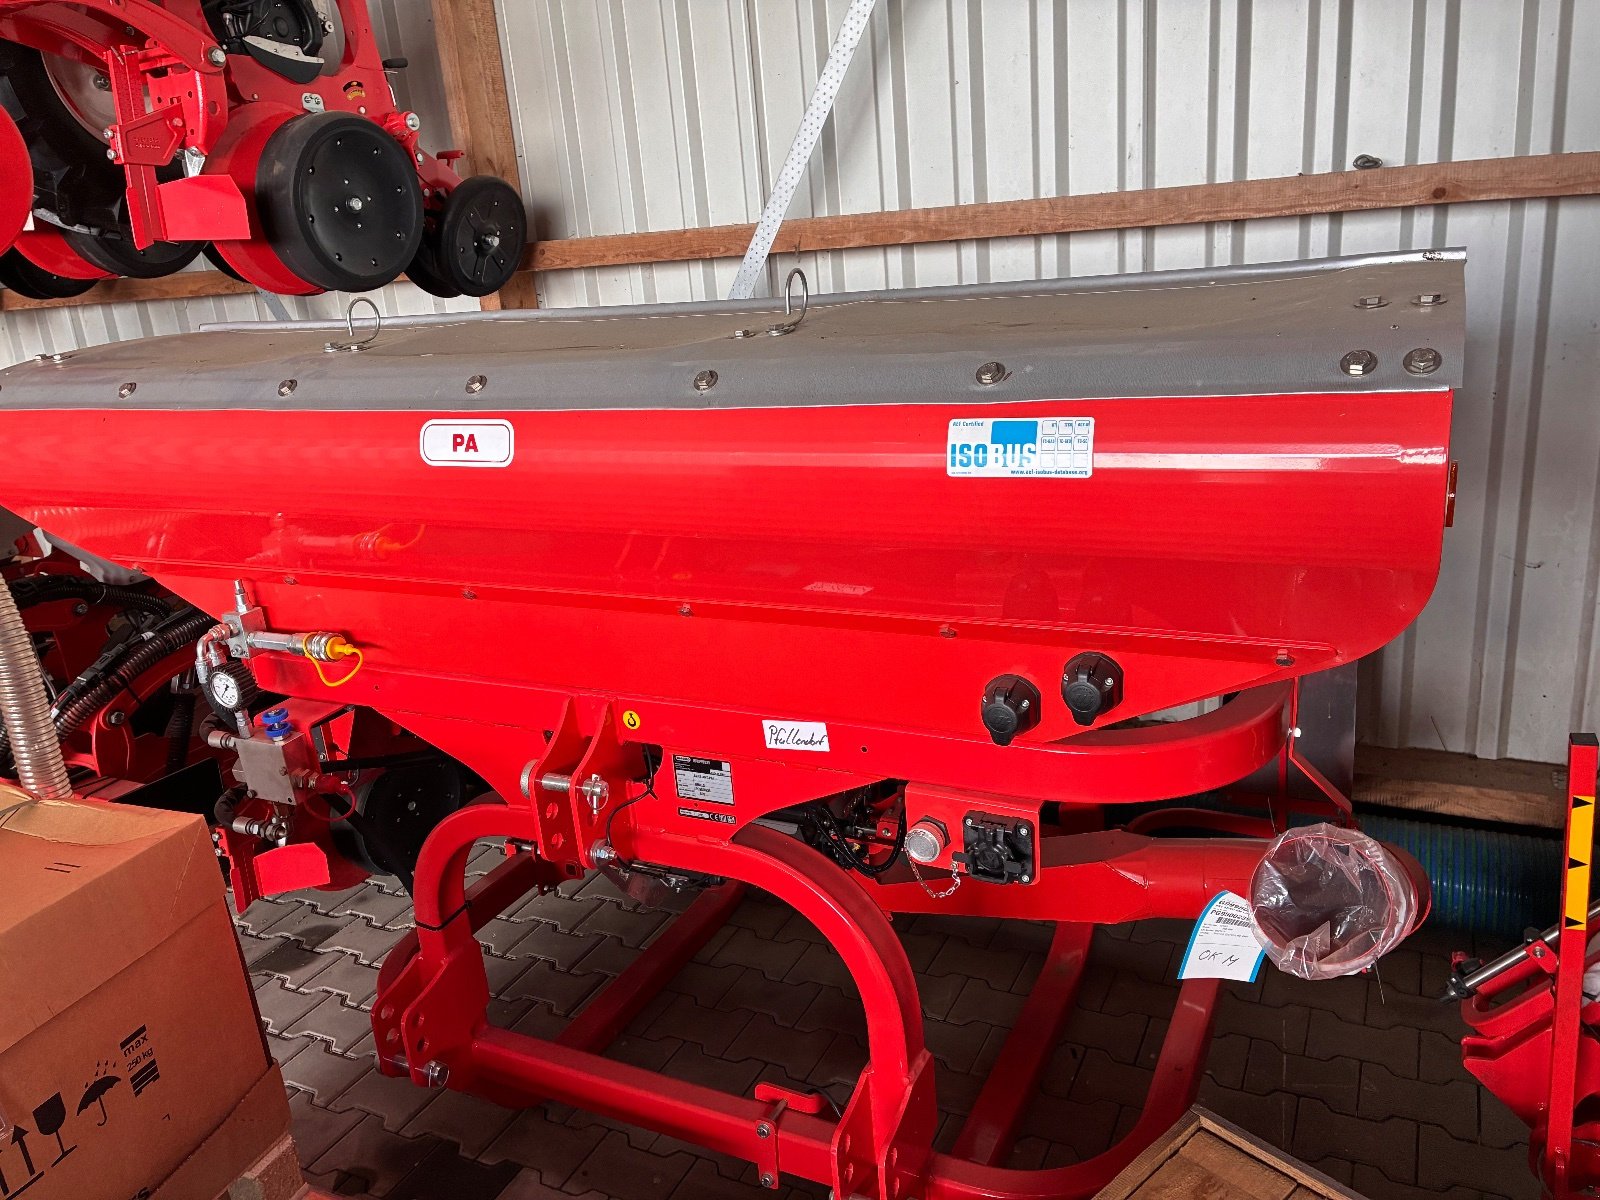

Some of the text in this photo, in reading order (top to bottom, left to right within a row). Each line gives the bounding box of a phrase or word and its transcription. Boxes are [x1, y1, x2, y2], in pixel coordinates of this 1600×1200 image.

[453, 433, 478, 452] PA
[1198, 949, 1223, 961] OK
[123, 1033, 148, 1058] max
[126, 1047, 154, 1072] 250 kg
